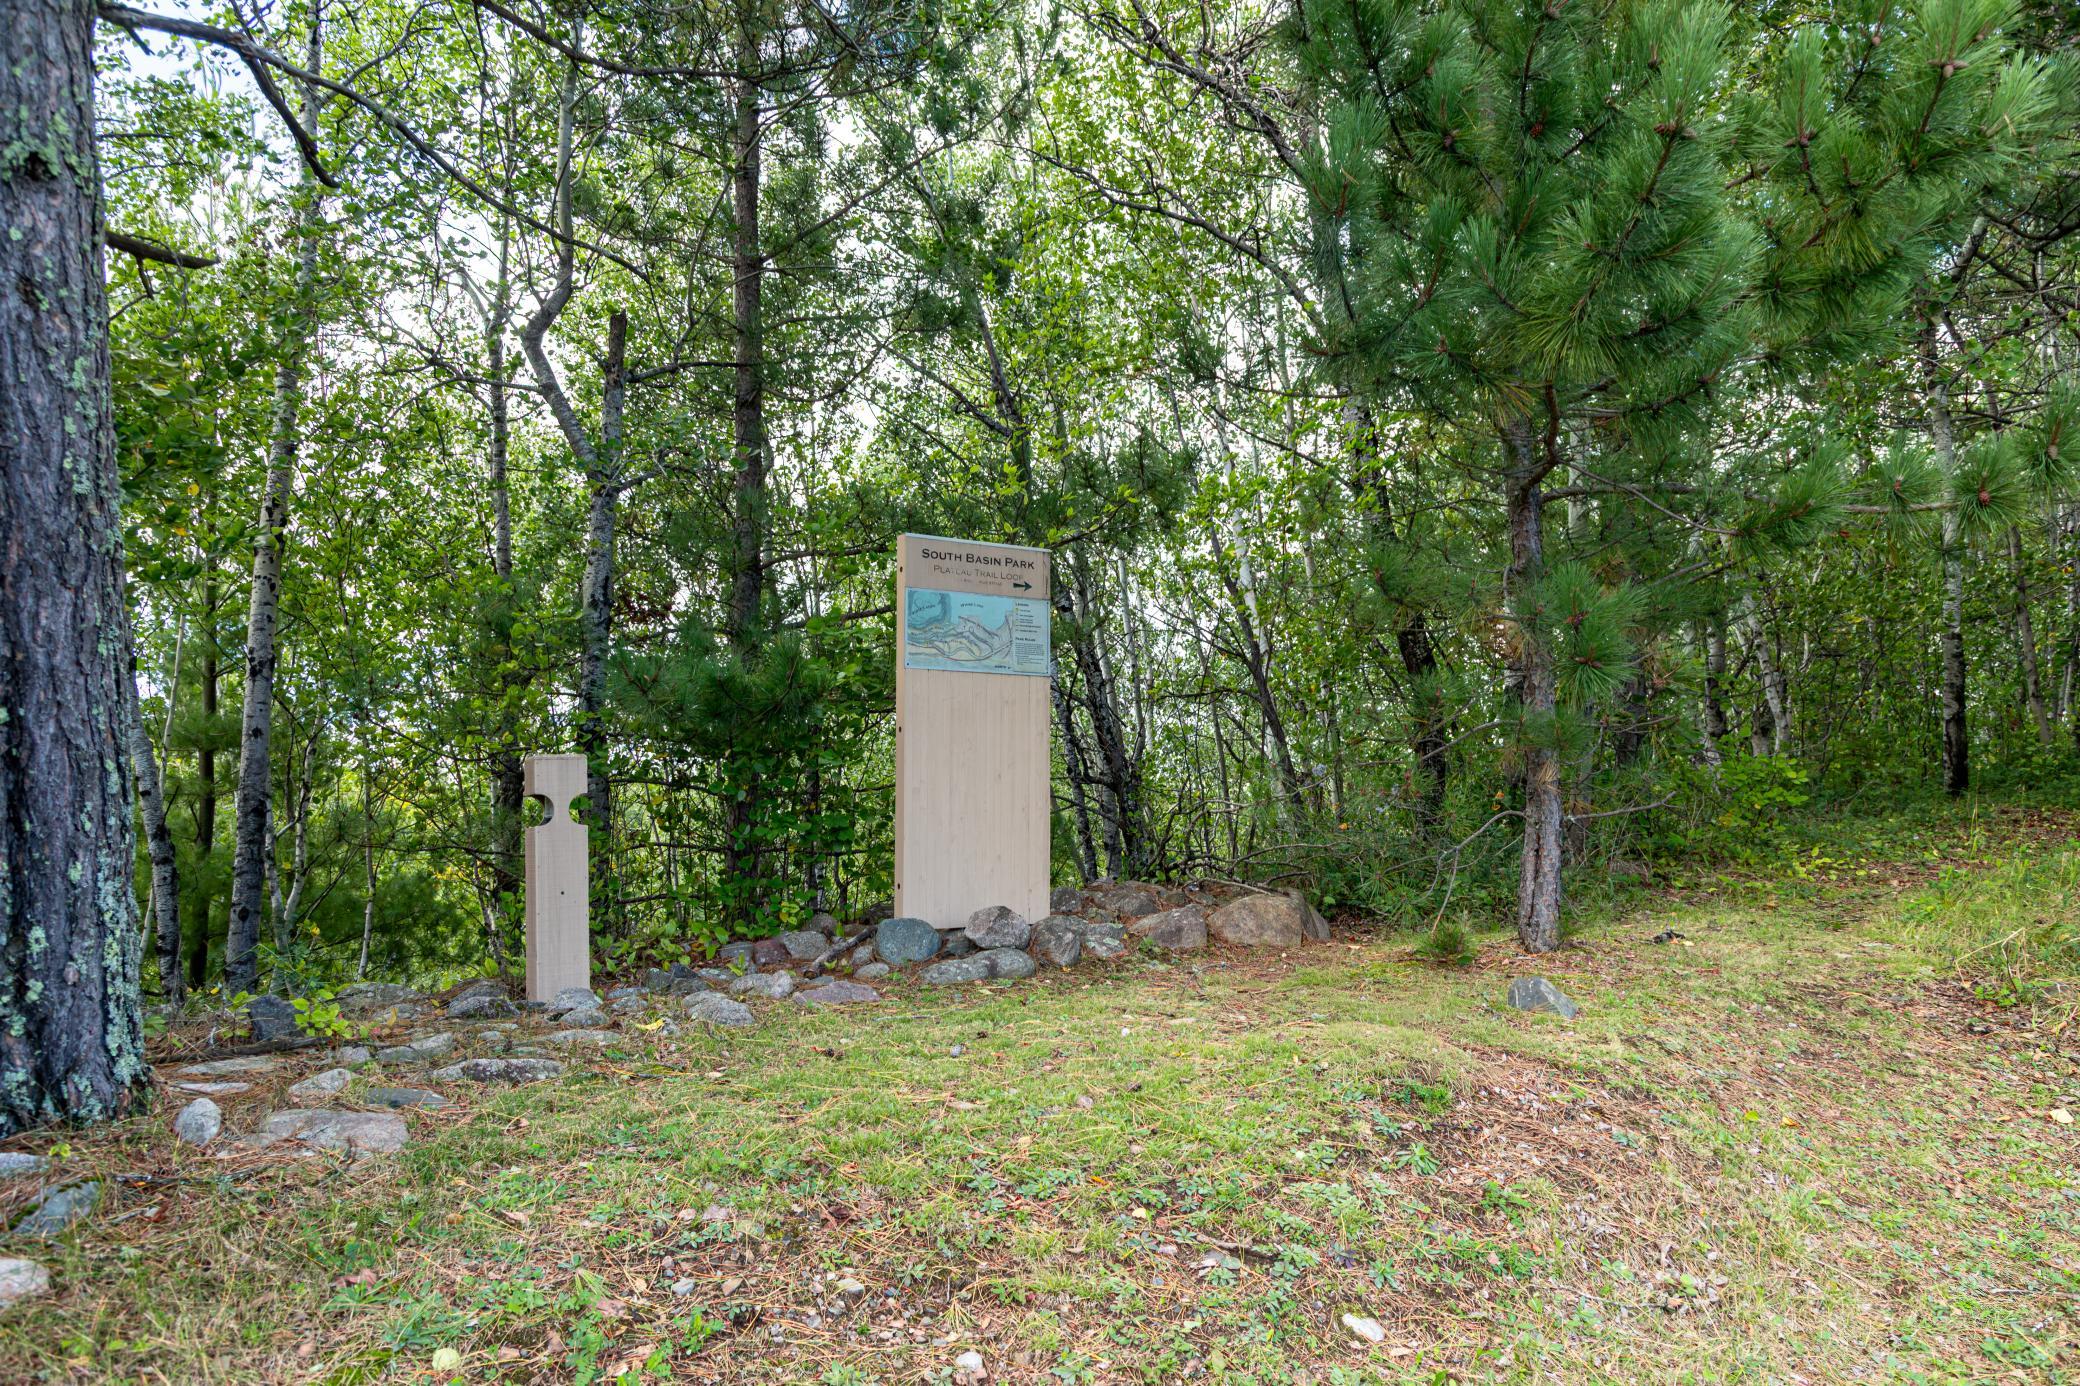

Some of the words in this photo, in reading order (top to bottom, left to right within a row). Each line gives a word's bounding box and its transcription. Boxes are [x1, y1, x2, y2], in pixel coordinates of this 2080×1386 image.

[922, 548, 962, 562] SOUTH
[966, 553, 1001, 567] BASIN
[1005, 557, 1035, 570] PARK
